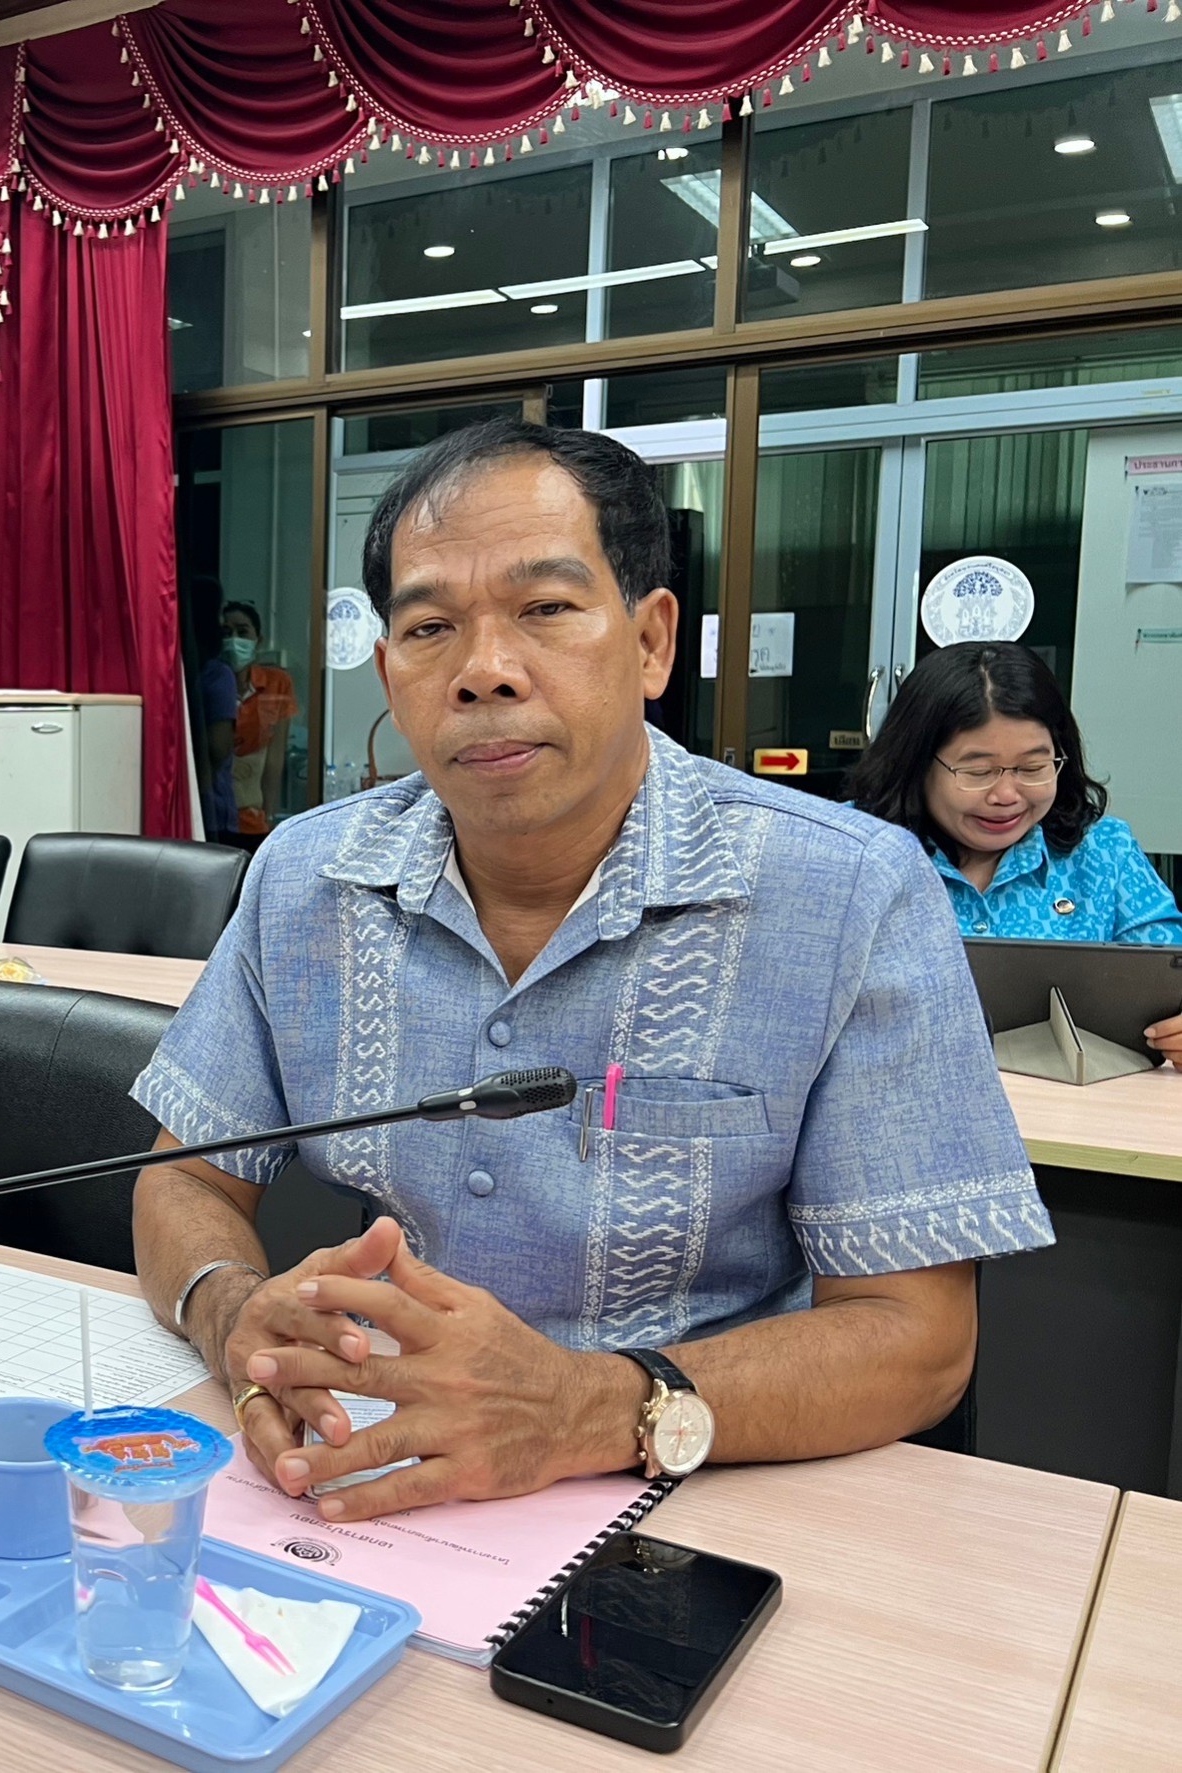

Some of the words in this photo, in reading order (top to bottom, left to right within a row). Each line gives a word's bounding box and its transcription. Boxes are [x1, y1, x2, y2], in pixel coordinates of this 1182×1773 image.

[289, 1512, 394, 1550] เอกสารประกอบ
